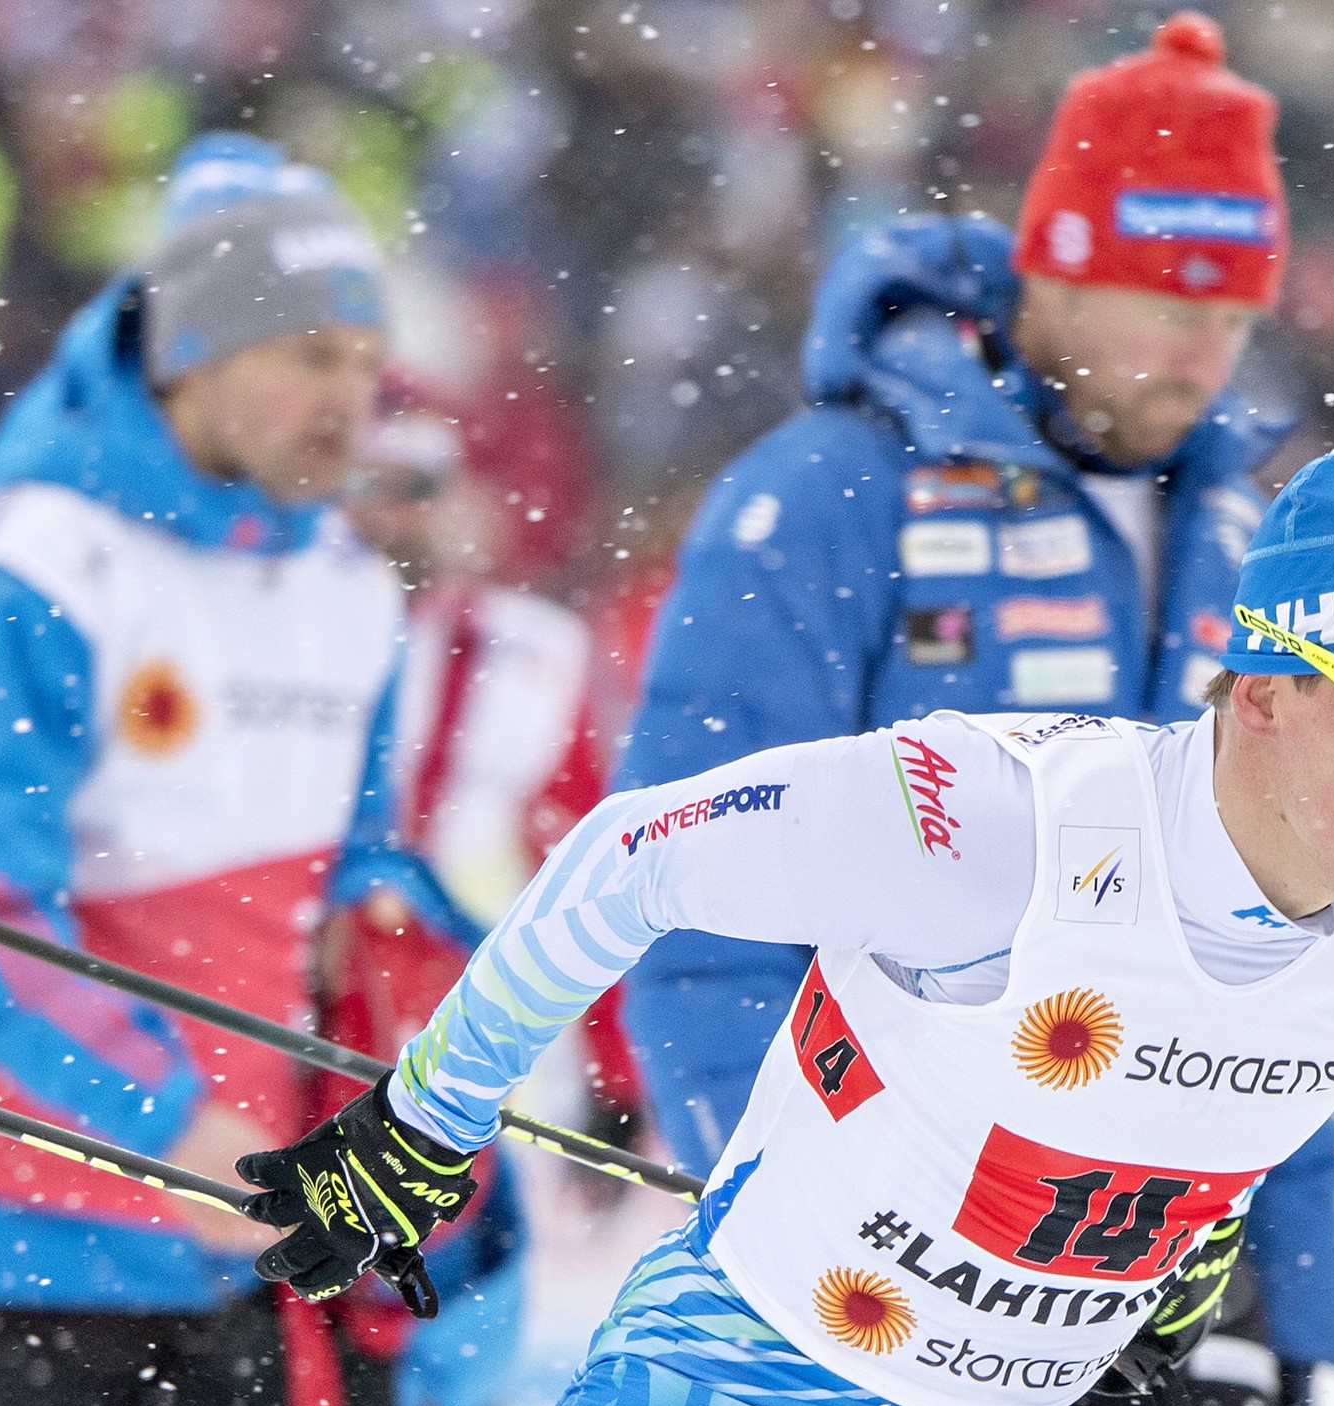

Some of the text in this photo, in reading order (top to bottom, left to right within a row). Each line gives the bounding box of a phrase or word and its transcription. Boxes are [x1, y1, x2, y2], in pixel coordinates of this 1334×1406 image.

[645, 783, 784, 842] INTERSPORT
[896, 736, 961, 856] Atria
[799, 990, 859, 1098] 14
[381, 1152, 408, 1176] Right
[1014, 1170, 1193, 1274] 14
